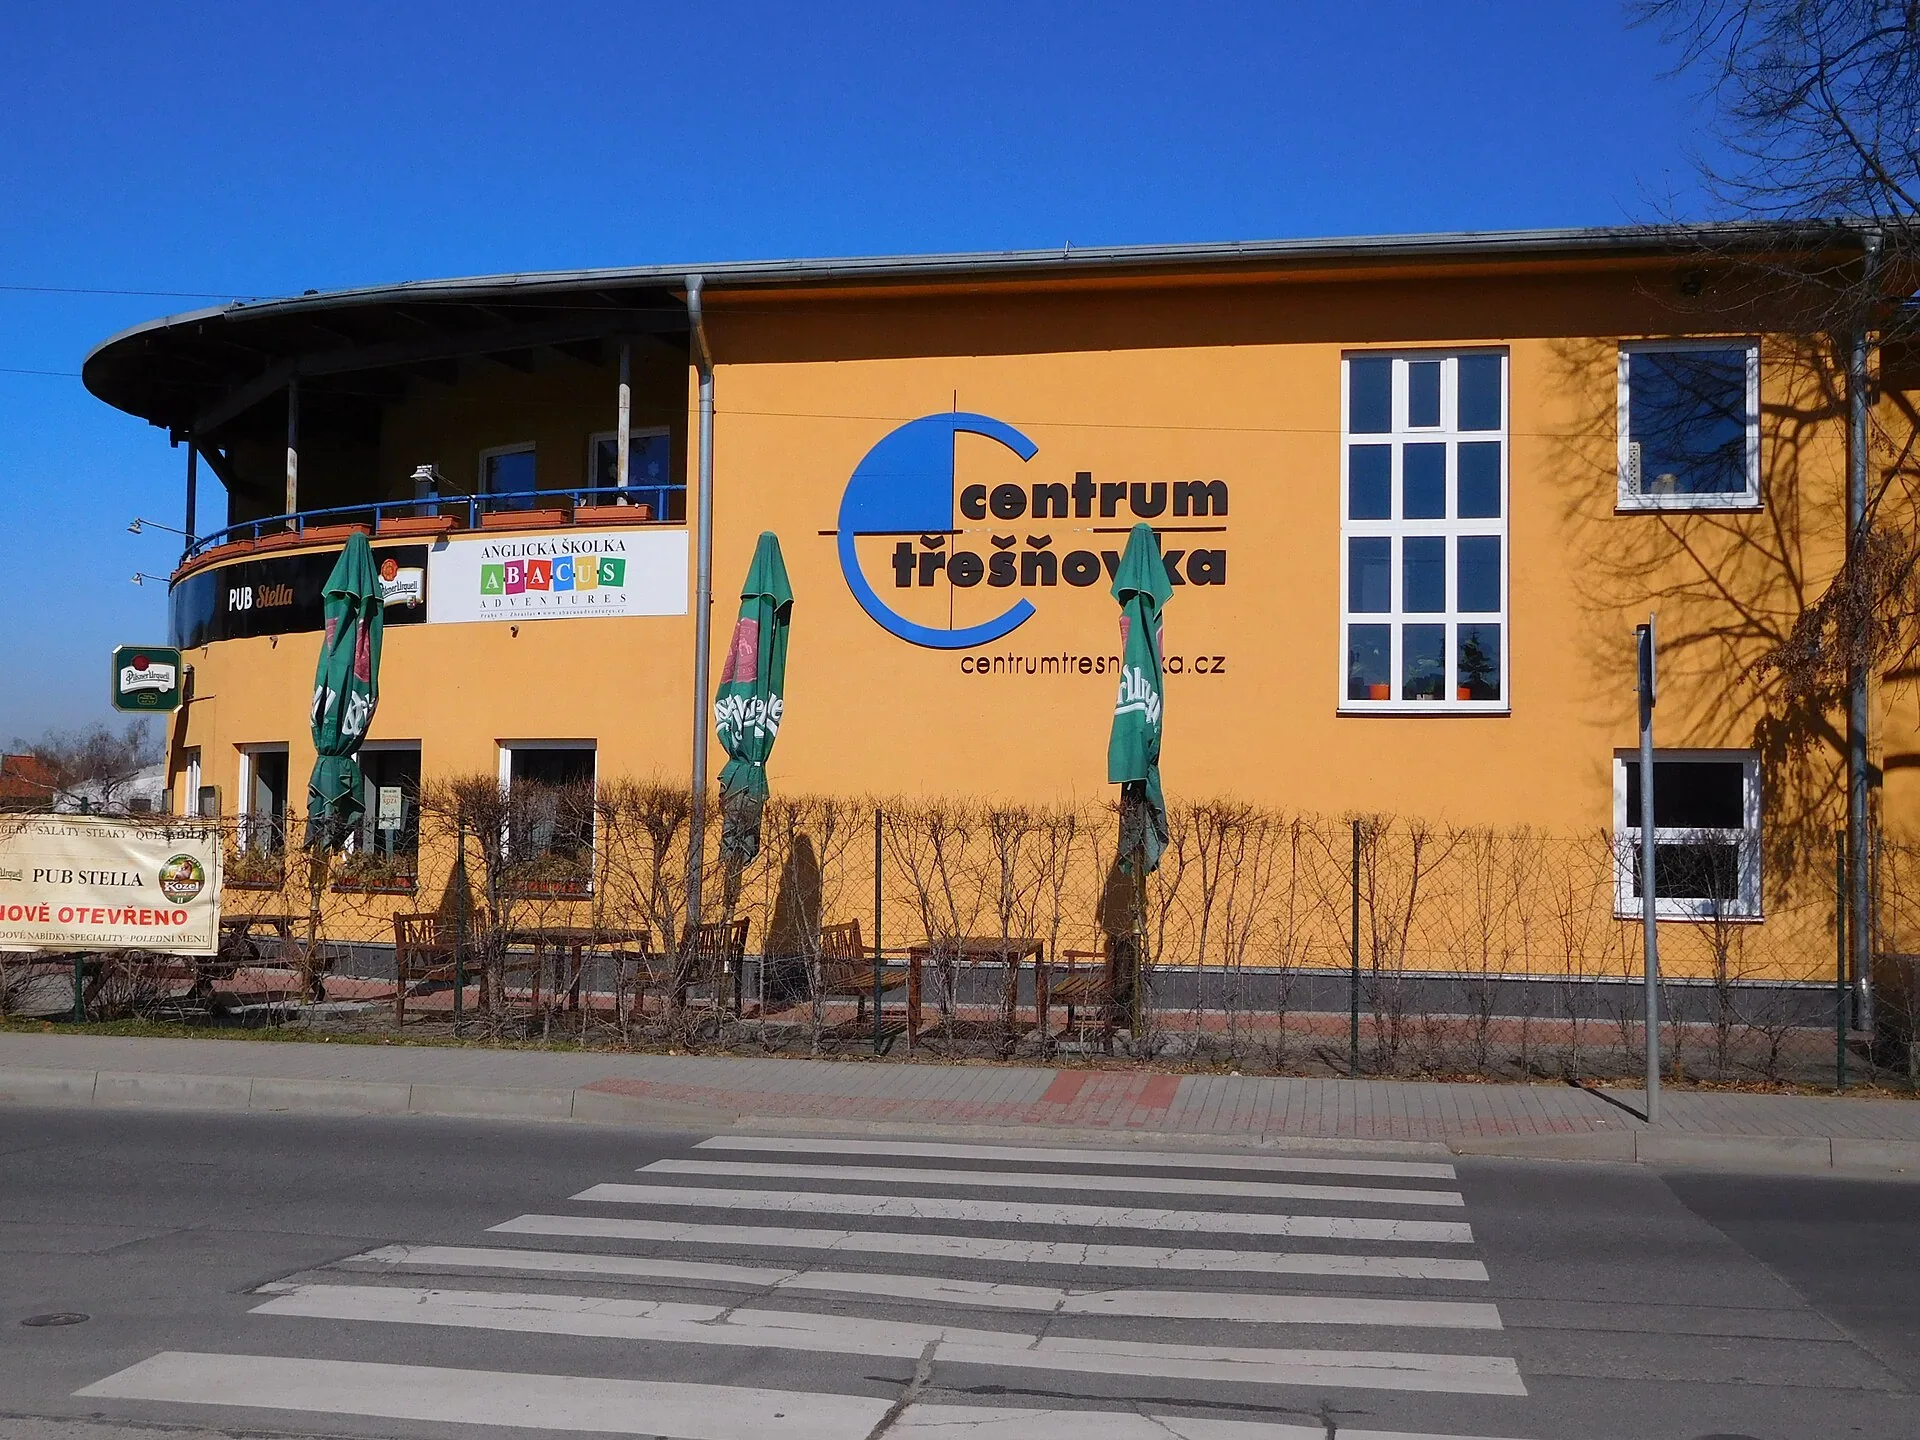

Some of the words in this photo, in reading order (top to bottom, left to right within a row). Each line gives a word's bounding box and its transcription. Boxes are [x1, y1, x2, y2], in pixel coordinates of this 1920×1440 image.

[959, 471, 1229, 520] centrum
[481, 537, 557, 559] ANGLICKÁ
[562, 537, 626, 554] ŠKOLKA
[485, 562, 616, 589] ABACUS
[229, 586, 253, 611] PUB
[256, 584, 293, 608] Stella
[480, 593, 627, 609] ADVENTURES
[961, 652, 1226, 675] centrumtresna.cz
[33, 869, 73, 884] PUB
[78, 870, 145, 887] STELLA
[164, 881, 200, 892] Kozel
[58, 905, 188, 926] OTEVŘENO
[178, 935, 208, 944] MENU
